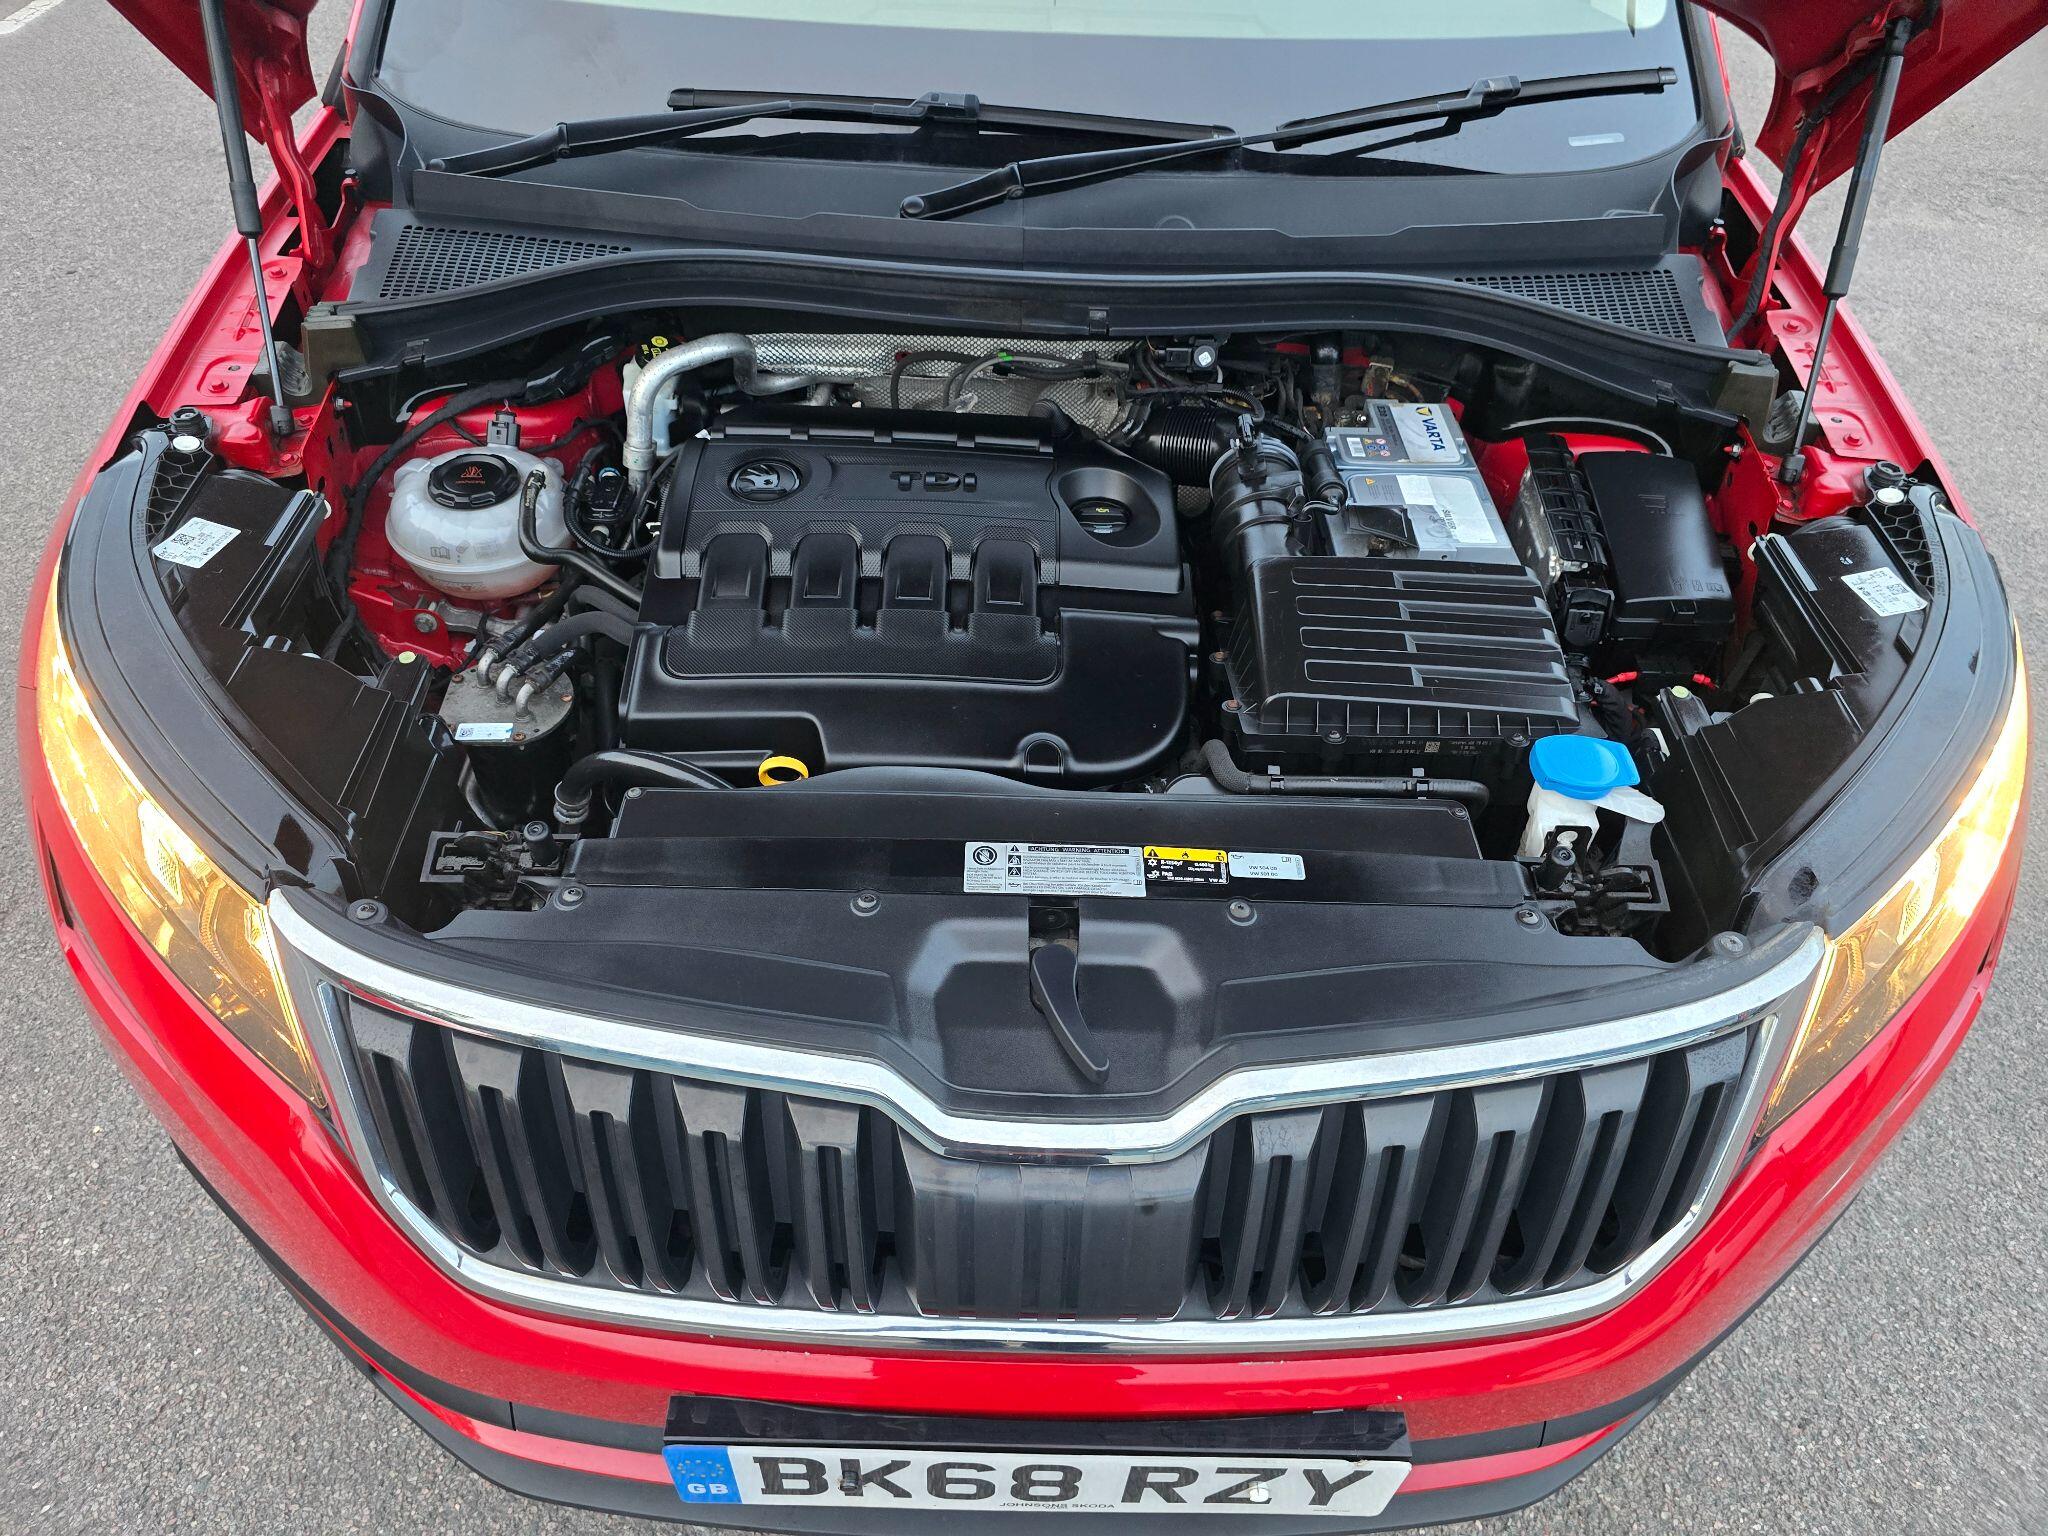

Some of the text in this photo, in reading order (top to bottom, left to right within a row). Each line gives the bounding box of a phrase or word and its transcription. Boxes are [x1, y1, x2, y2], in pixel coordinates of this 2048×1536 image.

[1422, 418, 1446, 451] VARTA
[889, 471, 978, 493] TDI
[687, 1483, 729, 1495] GB
[752, 1456, 1375, 1507] BK68 RZY
